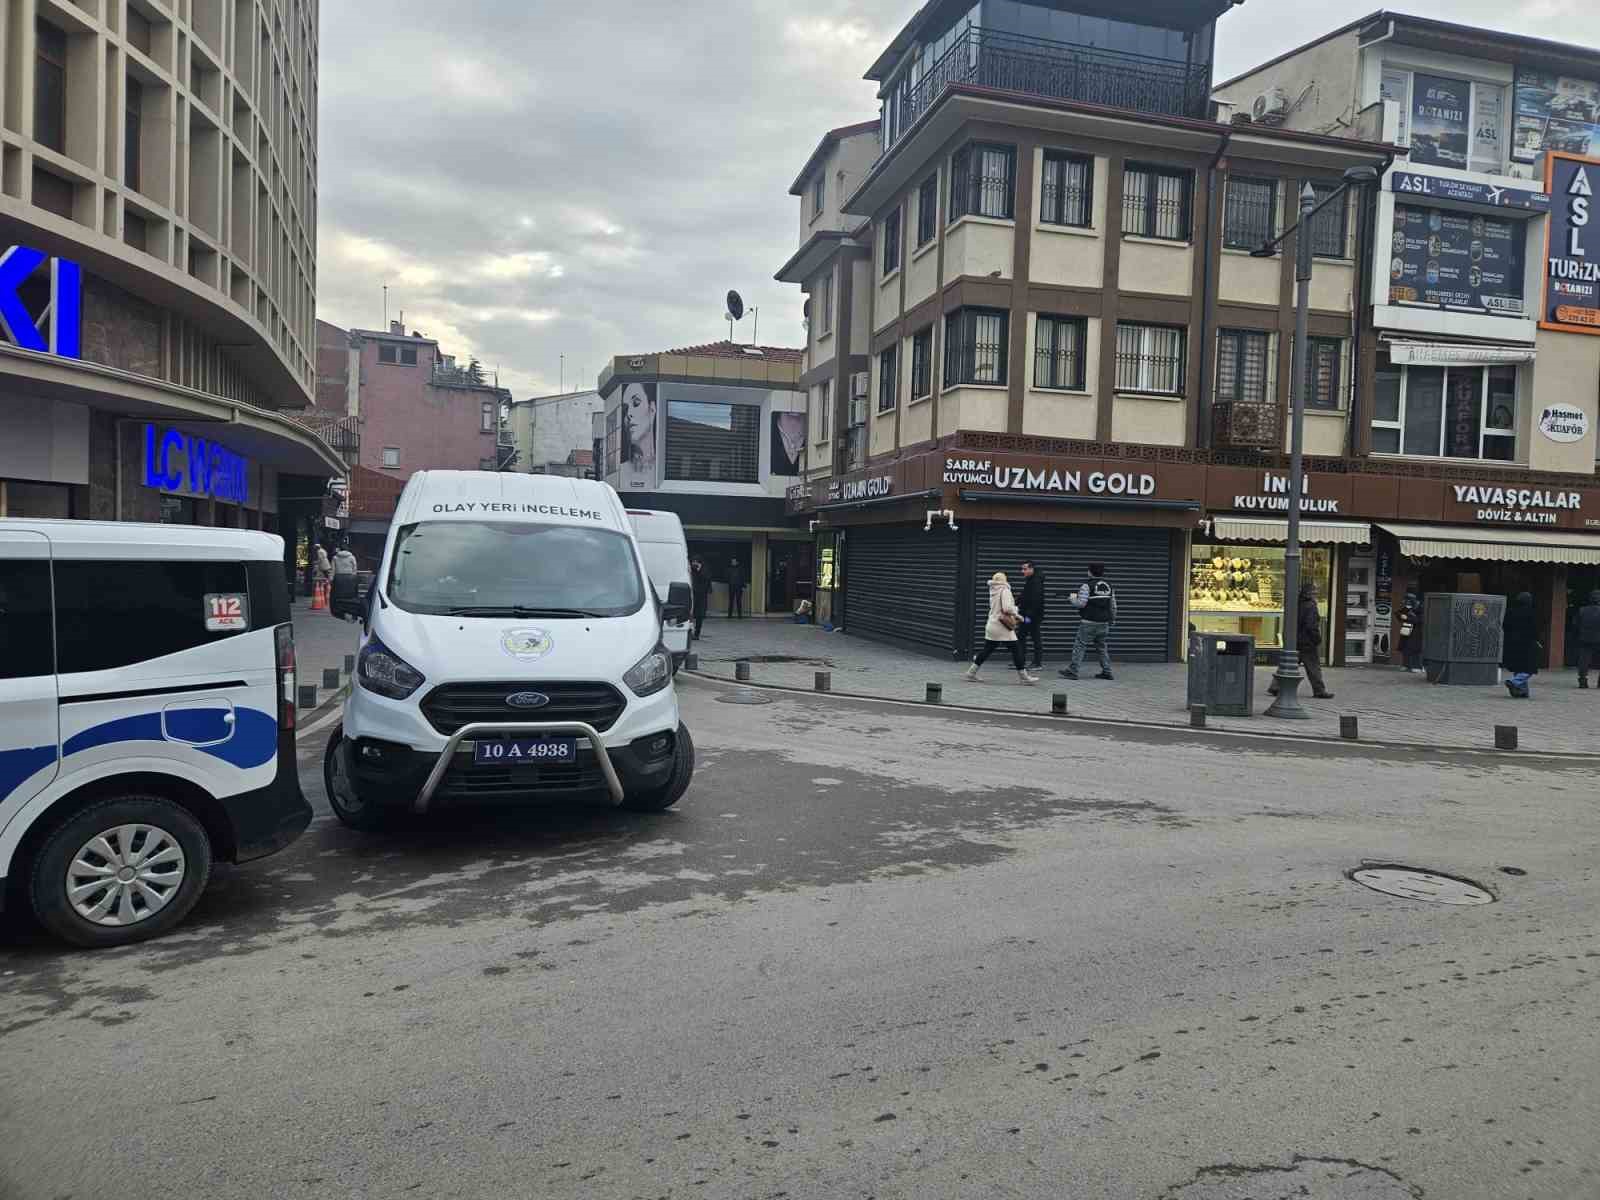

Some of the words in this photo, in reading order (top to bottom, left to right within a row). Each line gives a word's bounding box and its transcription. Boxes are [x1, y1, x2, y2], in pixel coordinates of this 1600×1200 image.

[1400, 175, 1431, 193] ASL
[1569, 165, 1592, 256] ASL
[145, 423, 183, 490] LC
[946, 459, 992, 471] SARRAF
[867, 476, 889, 497] GOLD
[943, 472, 993, 485] KUYUMCU
[994, 466, 1081, 491] UZMAN
[1088, 471, 1155, 495] GOLD
[1264, 472, 1309, 494] İNİ
[1234, 495, 1339, 513] KUYUMULUK
[1453, 485, 1582, 510] YAVAŞÇALAR
[432, 503, 476, 513] OLAY
[521, 504, 602, 521] İNCELEME
[1477, 508, 1512, 521] DÖVİZ
[1514, 512, 1522, 521] &
[1524, 512, 1557, 524] ALTIN
[210, 597, 241, 616] 112
[515, 694, 540, 705] Ford
[483, 744, 504, 758] 10
[507, 744, 522, 757] A
[527, 743, 568, 757] 4938
